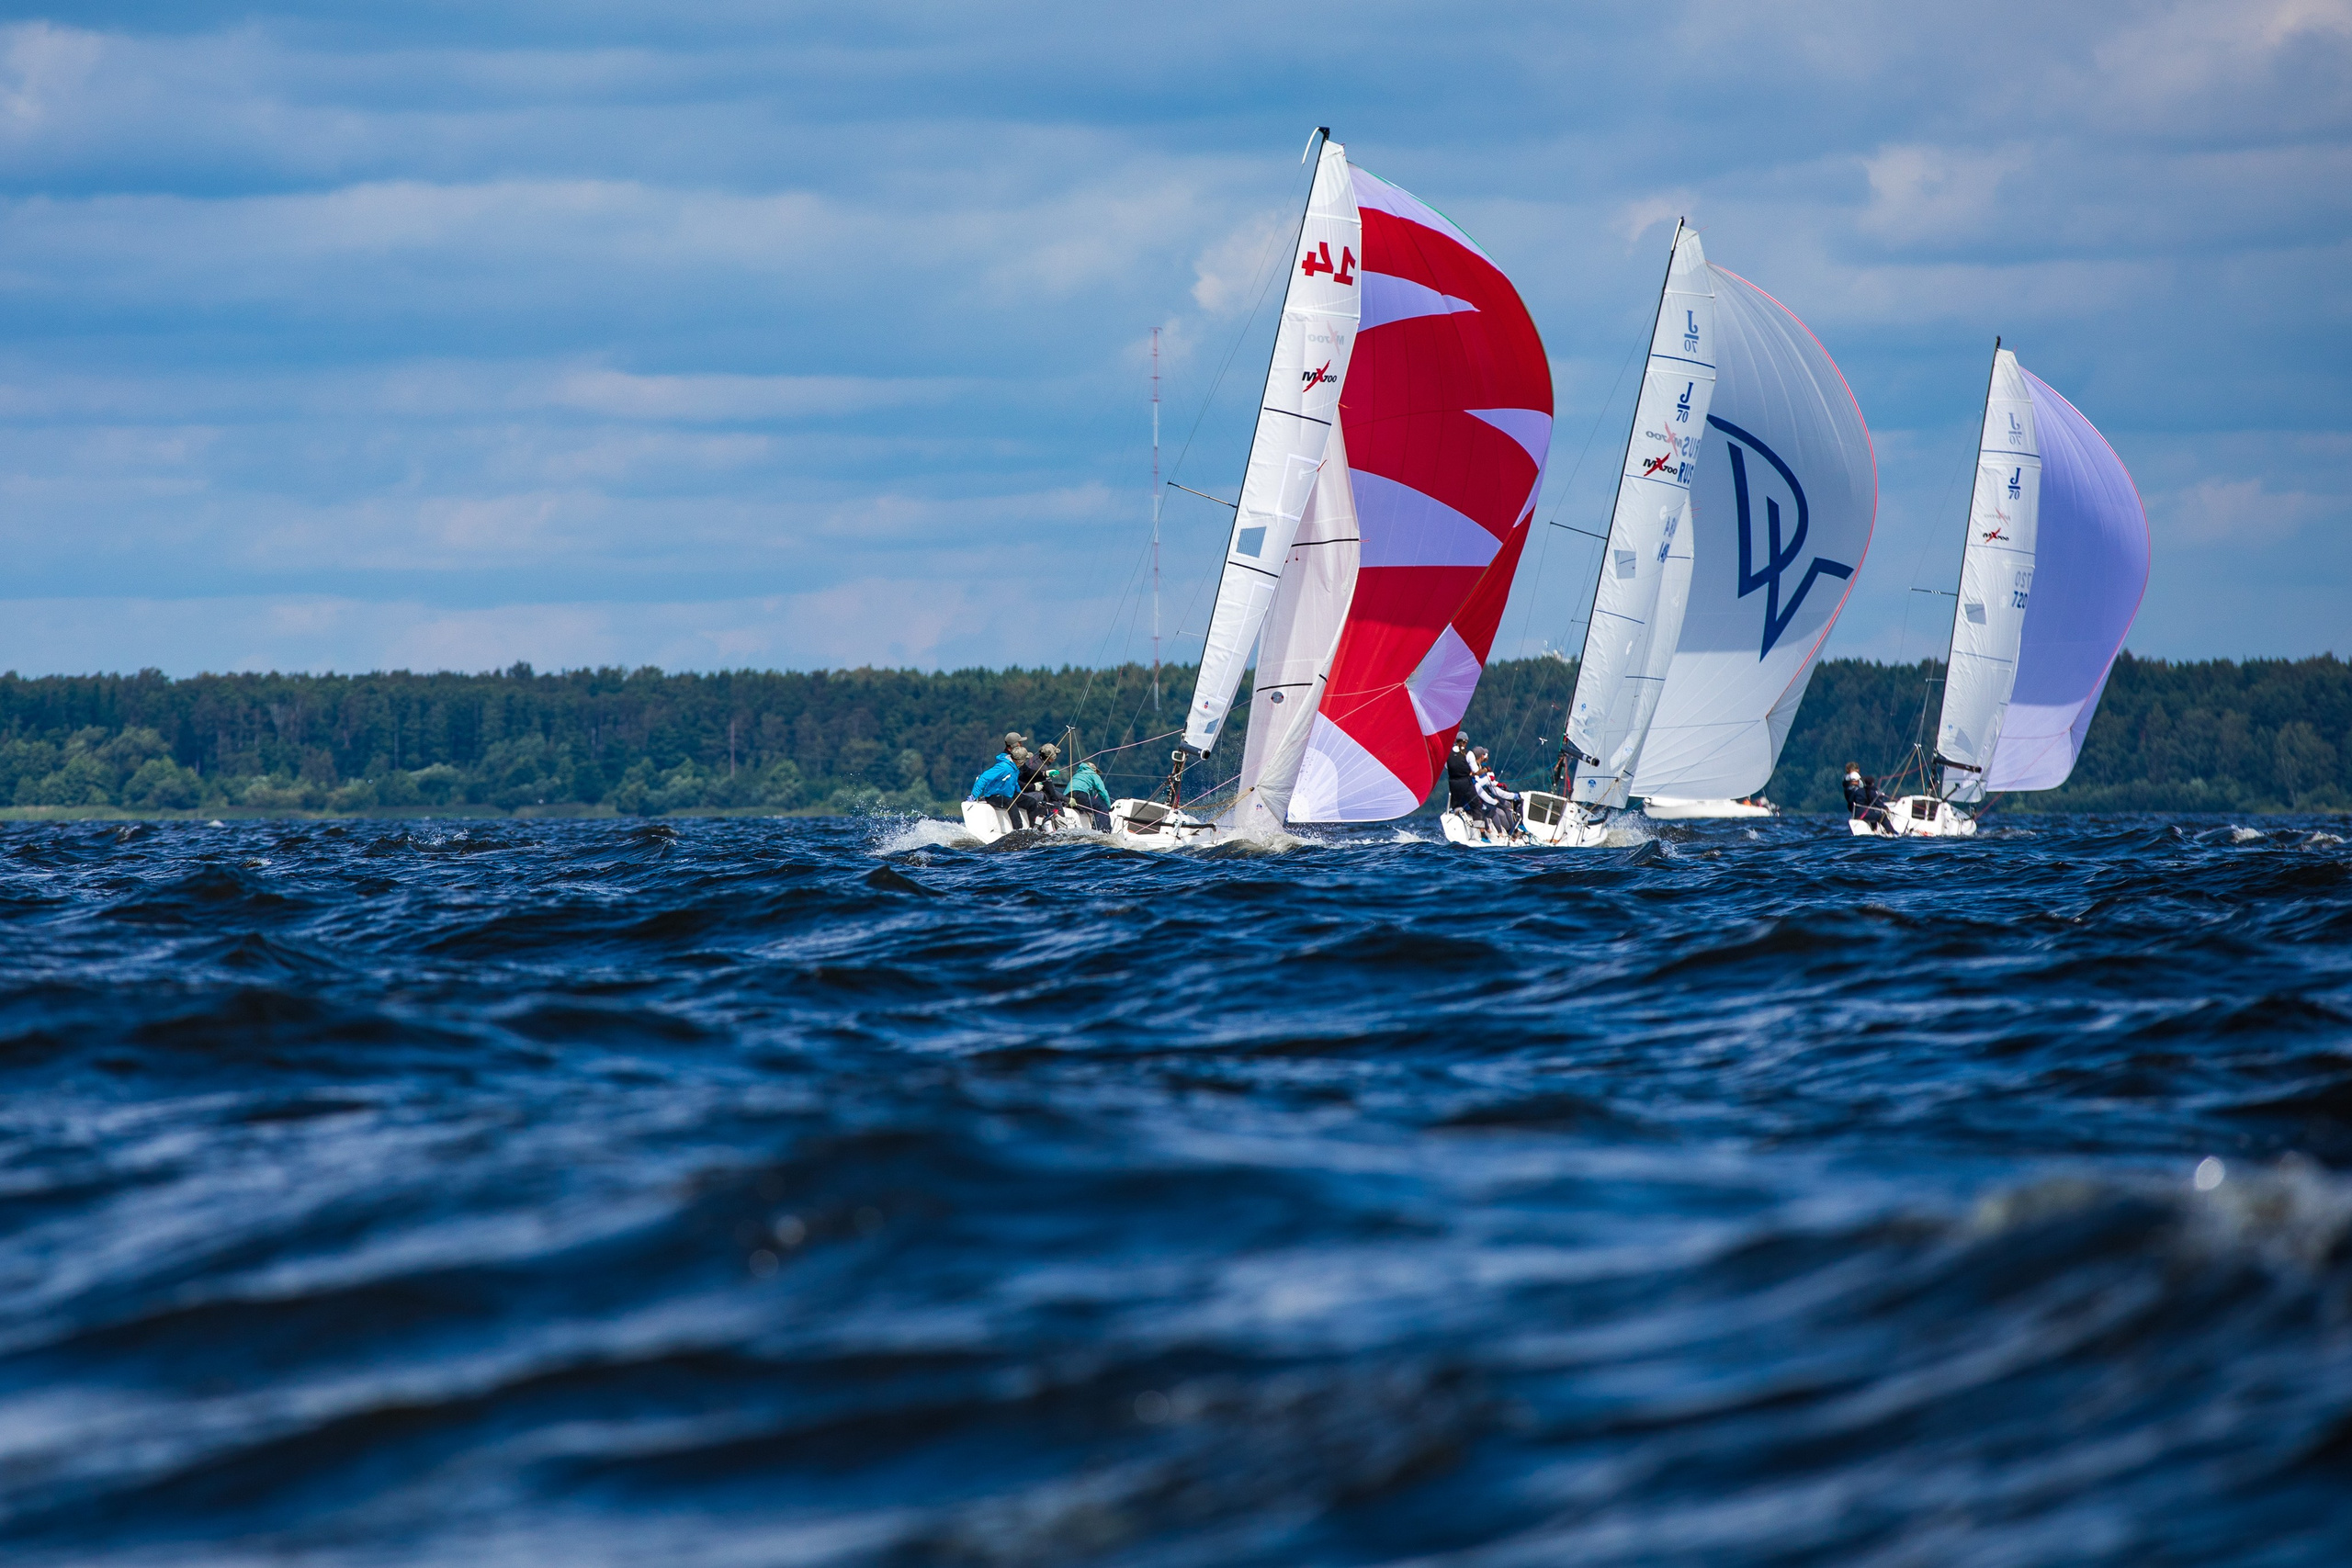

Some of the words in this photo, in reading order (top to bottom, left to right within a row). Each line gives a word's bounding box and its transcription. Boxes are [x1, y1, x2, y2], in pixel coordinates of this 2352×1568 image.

[1302, 359, 1337, 392] MX700
[1679, 382, 1694, 404] J
[1676, 410, 1689, 423] 70
[1643, 452, 1678, 477] MX700
[1677, 461, 1694, 484] RUS
[2009, 467, 2021, 485] J
[2008, 490, 2020, 501] 70
[2011, 590, 2028, 609] 720
